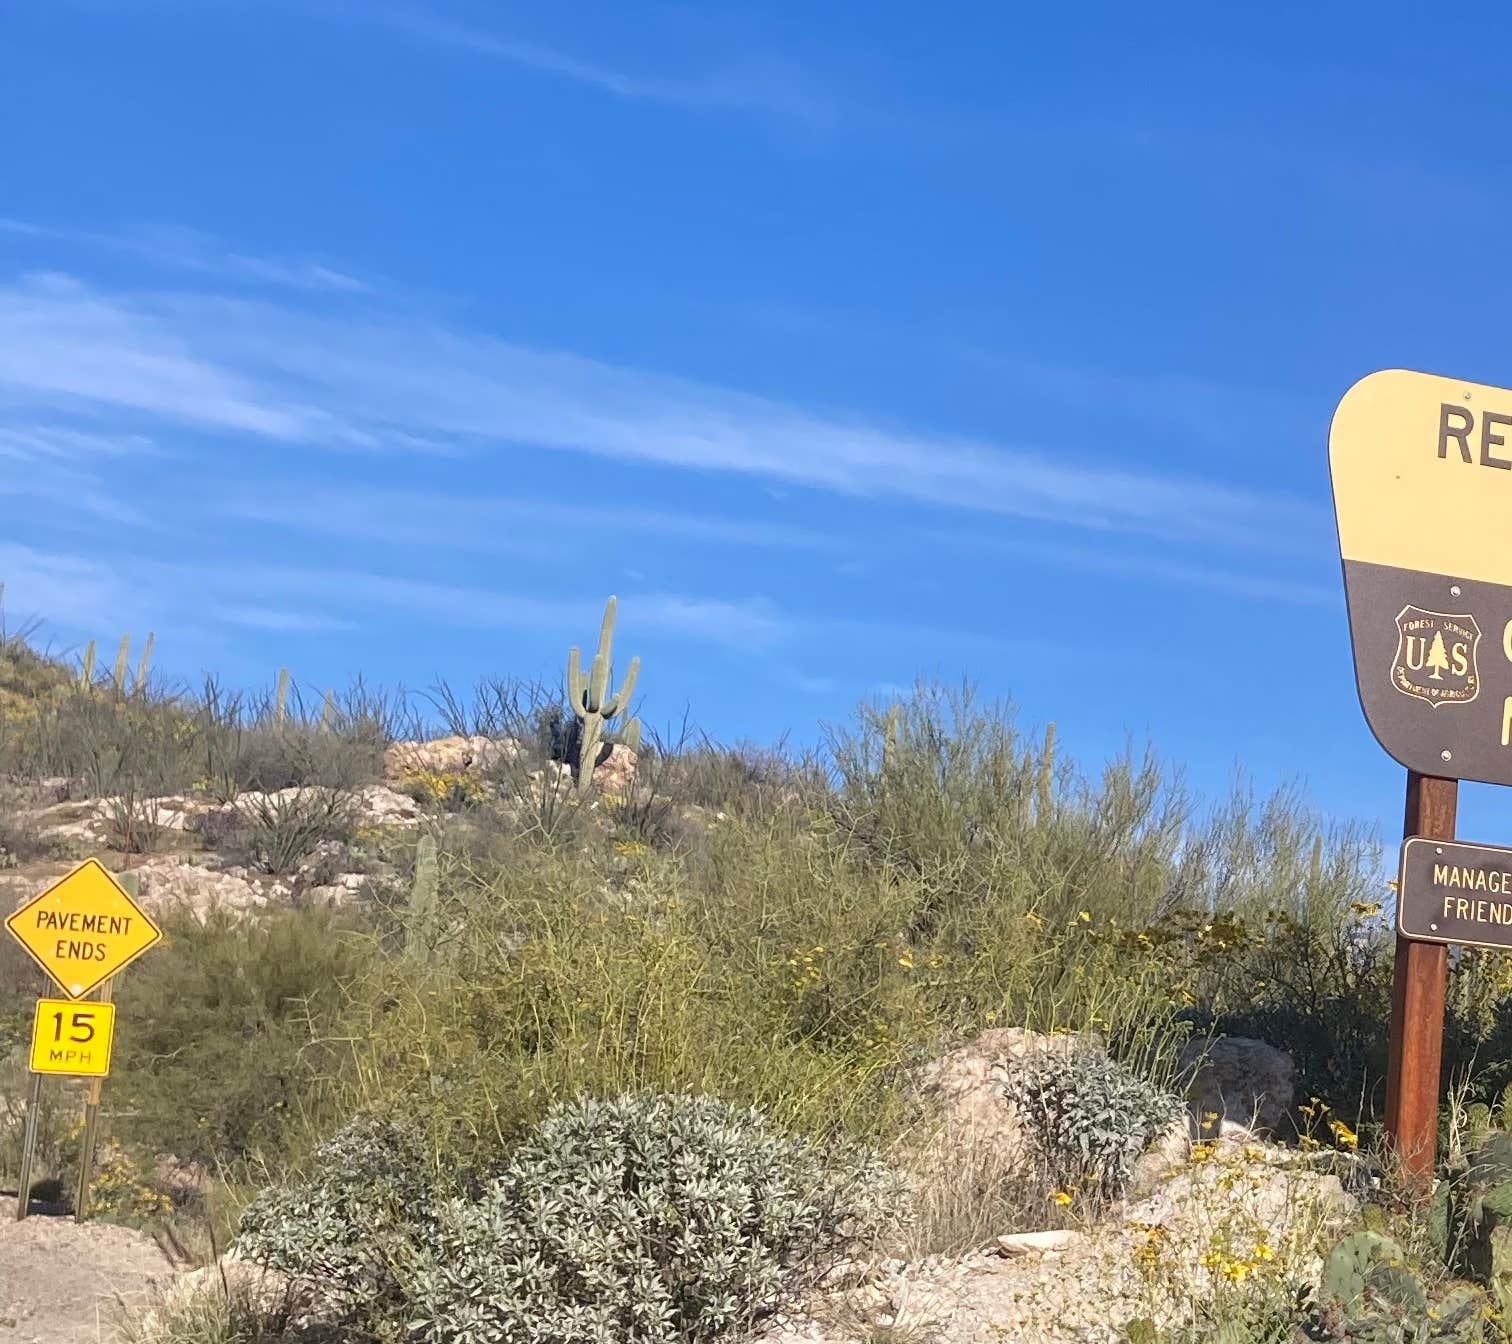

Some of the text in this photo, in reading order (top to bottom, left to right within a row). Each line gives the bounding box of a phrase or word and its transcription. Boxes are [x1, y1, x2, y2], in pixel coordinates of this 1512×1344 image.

[1403, 619, 1434, 632] FOREST
[36, 910, 133, 936] PAVEMENT
[55, 940, 107, 962] ENDS
[52, 1011, 96, 1044] 15
[49, 1050, 92, 1065] MPH
